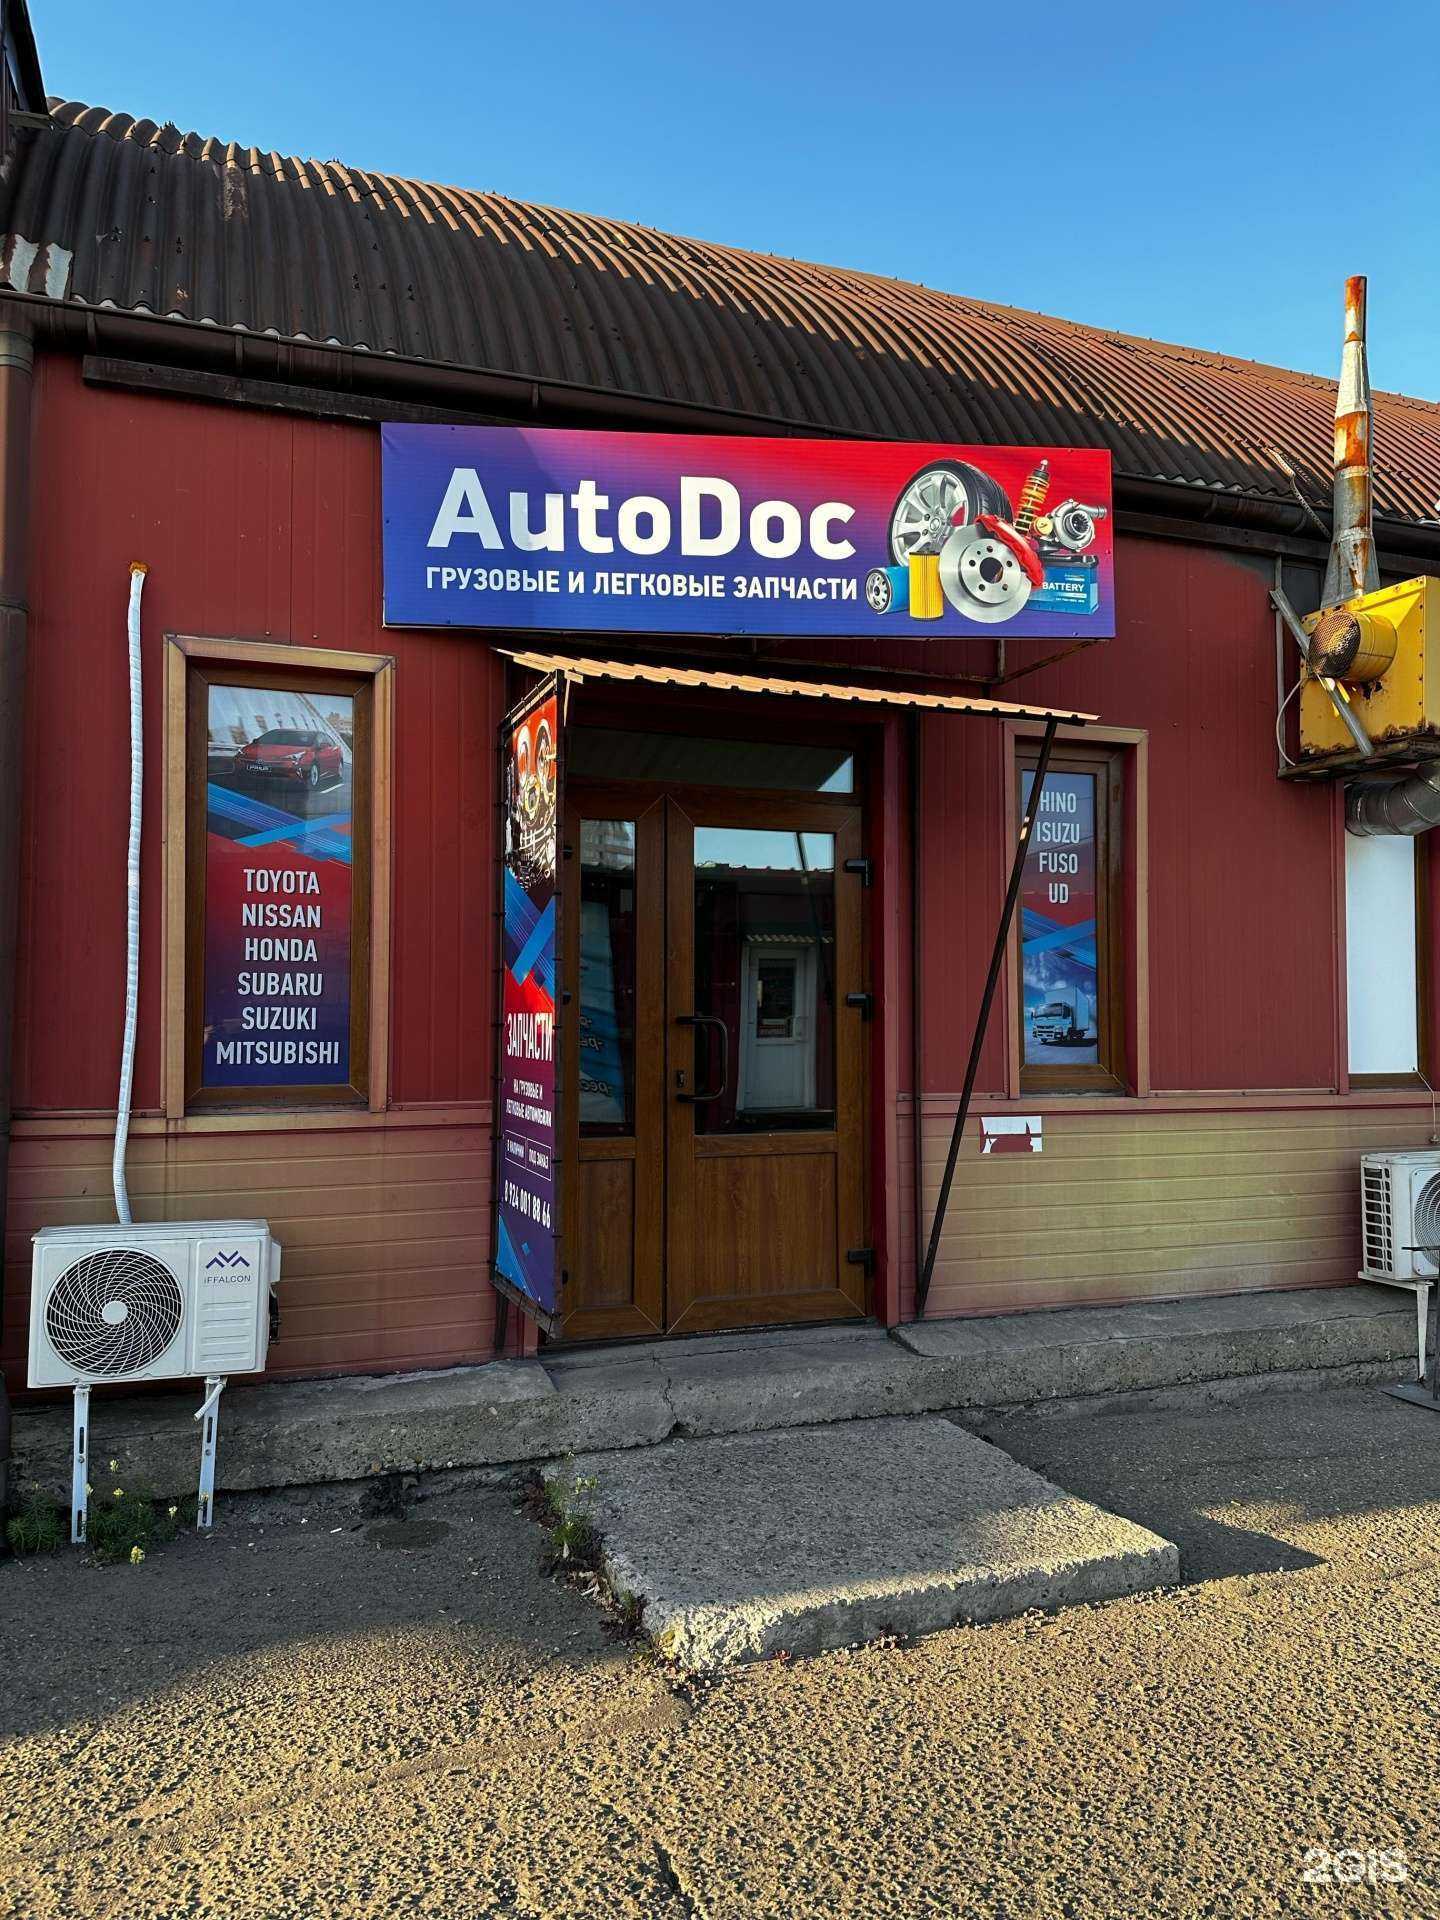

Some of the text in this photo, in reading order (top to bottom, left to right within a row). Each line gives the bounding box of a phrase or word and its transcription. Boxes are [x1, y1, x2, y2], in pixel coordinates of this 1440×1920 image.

[427, 467, 856, 561] AutoDoc
[426, 566, 857, 601] ГРУЗОВЫЕ И ЛЕГКОВЫЕ ЗАПЧАСТИ
[1042, 581, 1085, 592] BATTERY
[1040, 791, 1077, 813] HINO
[1036, 821, 1080, 844] ISUZU
[1039, 852, 1078, 874] FUSO
[243, 867, 320, 894] TOYOTA
[1049, 883, 1069, 904] UD
[241, 903, 321, 928] NISSAN
[244, 937, 318, 962] HONDA
[237, 971, 323, 996] SUBARU
[241, 1006, 317, 1031] SUZUKI
[507, 1012, 553, 1062] ЗАПЧАСТИ
[216, 1040, 340, 1065] MITSUBISHI
[505, 1179, 551, 1229] 8 924 001 88 66
